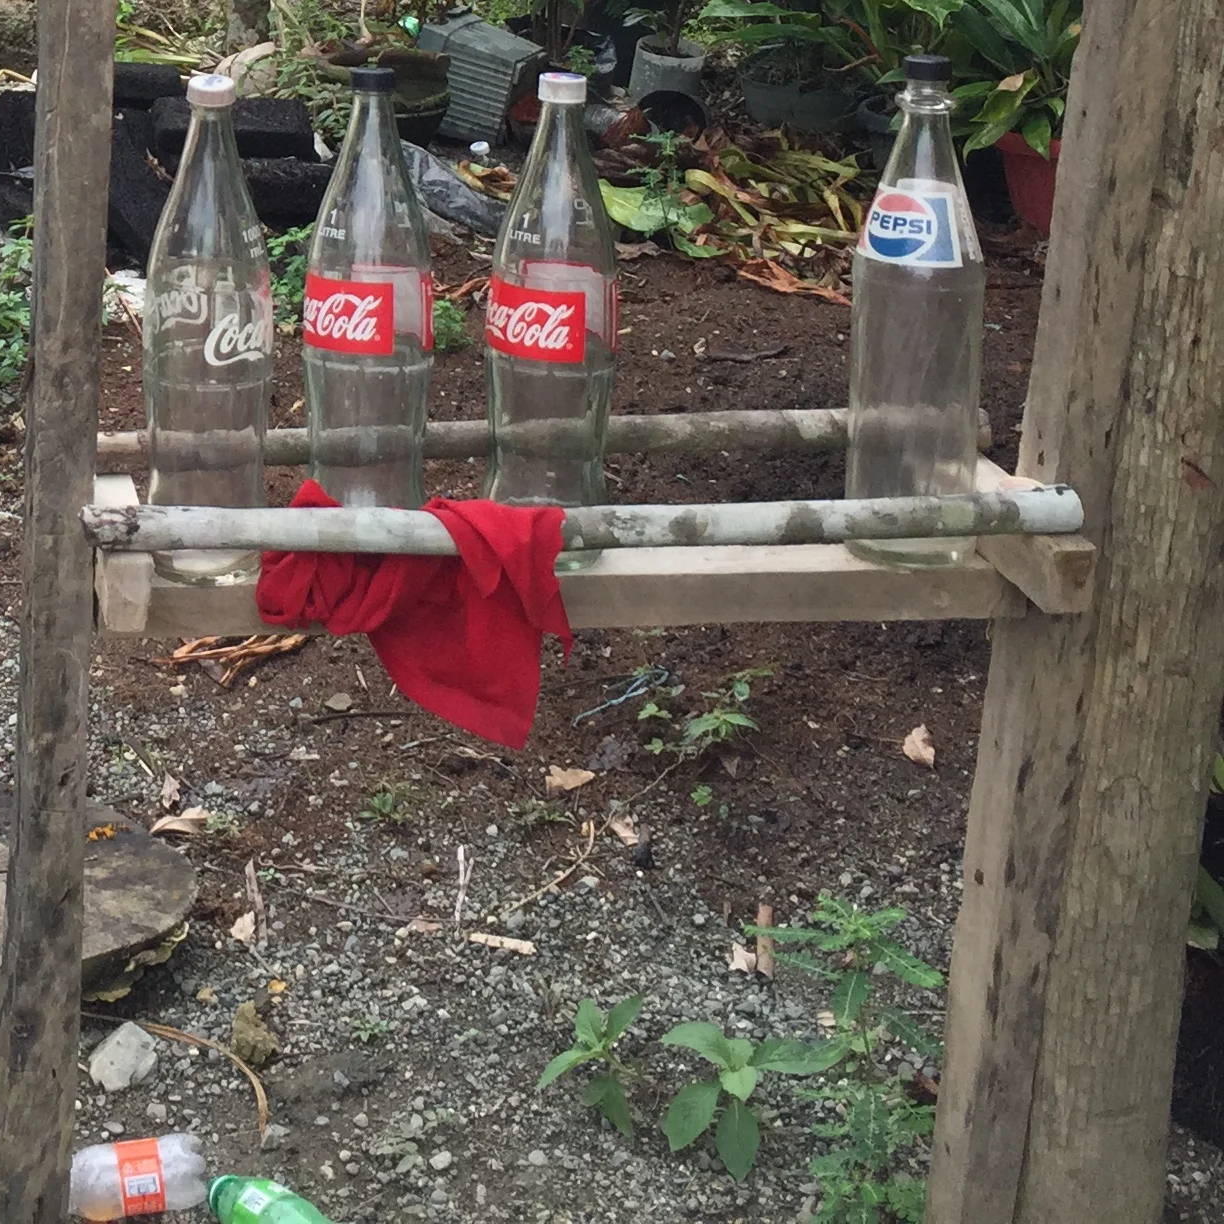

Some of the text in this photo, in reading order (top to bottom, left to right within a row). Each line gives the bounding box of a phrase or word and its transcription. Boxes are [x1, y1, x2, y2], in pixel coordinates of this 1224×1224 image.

[330, 208, 338, 225] 1
[522, 212, 531, 229] 1
[869, 209, 933, 236] PEPSI
[508, 230, 542, 245] LITRE
